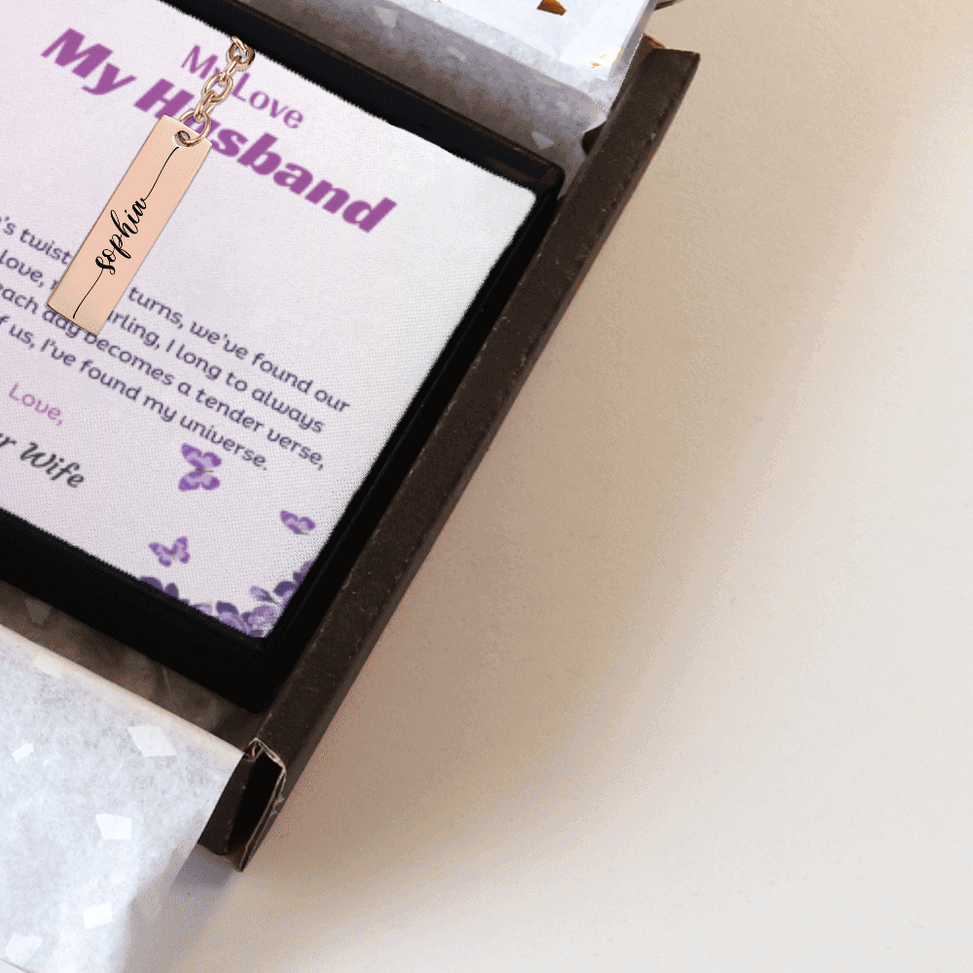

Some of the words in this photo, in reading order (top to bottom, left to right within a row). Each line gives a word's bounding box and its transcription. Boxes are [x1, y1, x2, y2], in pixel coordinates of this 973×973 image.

[41, 27, 137, 95] My
[180, 44, 226, 89] M
[232, 72, 304, 129] Love
[19, 228, 73, 266] twist
[128, 287, 184, 328] turns,
[189, 321, 249, 360] we've
[251, 352, 314, 395] found
[313, 388, 351, 413] our
[8, 383, 63, 426] Love,
[9, 324, 36, 349] us,
[40, 338, 77, 366] I've
[79, 359, 142, 401] found
[143, 393, 178, 423] my
[179, 414, 268, 471] universe.
[107, 309, 161, 350] rling,
[165, 339, 176, 353] I
[176, 343, 222, 380] long
[225, 372, 248, 392] to
[251, 387, 325, 435] always
[20, 442, 84, 488] Wife
[177, 381, 192, 397] a
[195, 388, 264, 433] tender
[266, 427, 324, 471] verse,
